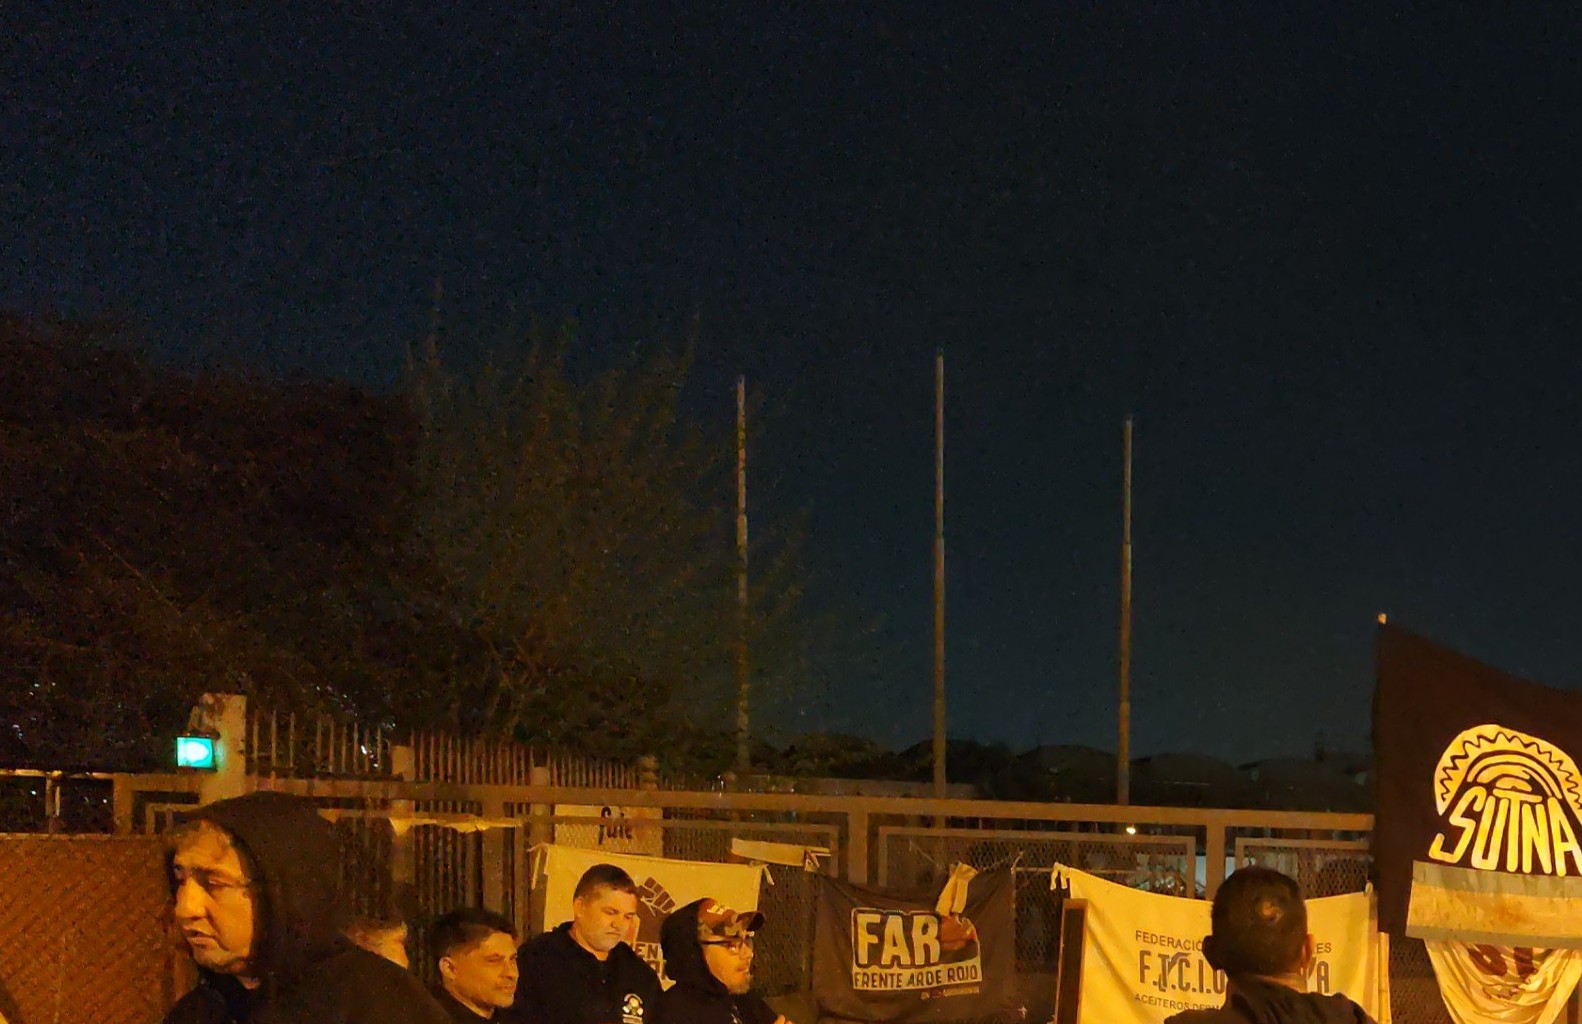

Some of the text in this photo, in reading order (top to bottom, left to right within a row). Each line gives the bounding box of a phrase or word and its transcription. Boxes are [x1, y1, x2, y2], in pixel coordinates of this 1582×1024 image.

[857, 913, 941, 965] FAR
[854, 965, 978, 988] FRENTE ARDE ROJO
